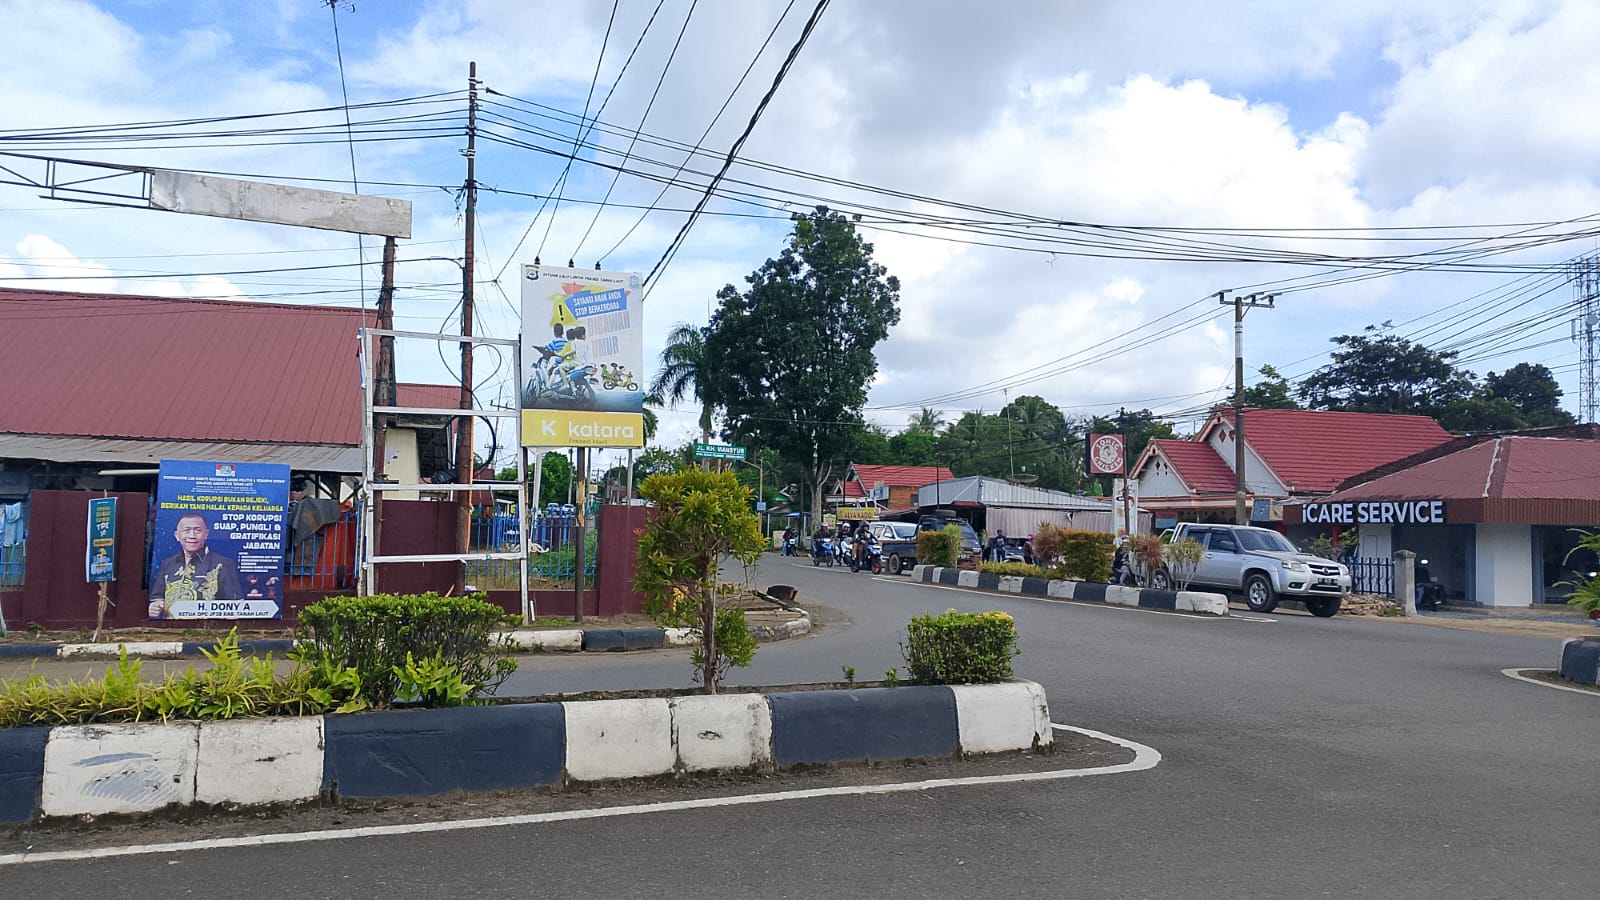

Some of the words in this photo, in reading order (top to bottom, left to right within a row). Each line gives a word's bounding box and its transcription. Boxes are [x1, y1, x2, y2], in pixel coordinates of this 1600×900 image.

[573, 296, 594, 307] SAYANGI
[594, 293, 608, 304] ANAK
[608, 291, 622, 302] ANDA
[575, 307, 588, 316] STOP
[589, 301, 620, 314] BERKENDARA
[541, 420, 556, 436] K
[569, 421, 634, 438] katara
[718, 446, 745, 454] MANSYUR
[177, 494, 195, 502] HASIL
[197, 495, 223, 503] KORUPSI
[206, 503, 226, 511] HALAL
[1302, 503, 1354, 523] iCARE
[1357, 501, 1444, 523] SERVICE
[222, 513, 245, 521] STOP
[246, 514, 282, 522] KORUPSI
[213, 522, 239, 531] SUAP,
[240, 523, 271, 531] PUNGLI
[230, 532, 281, 541] GRATIFIKASI
[243, 541, 280, 550] JABATAN
[198, 602, 208, 611] H.
[211, 602, 239, 611] DONY
[243, 602, 251, 611] A
